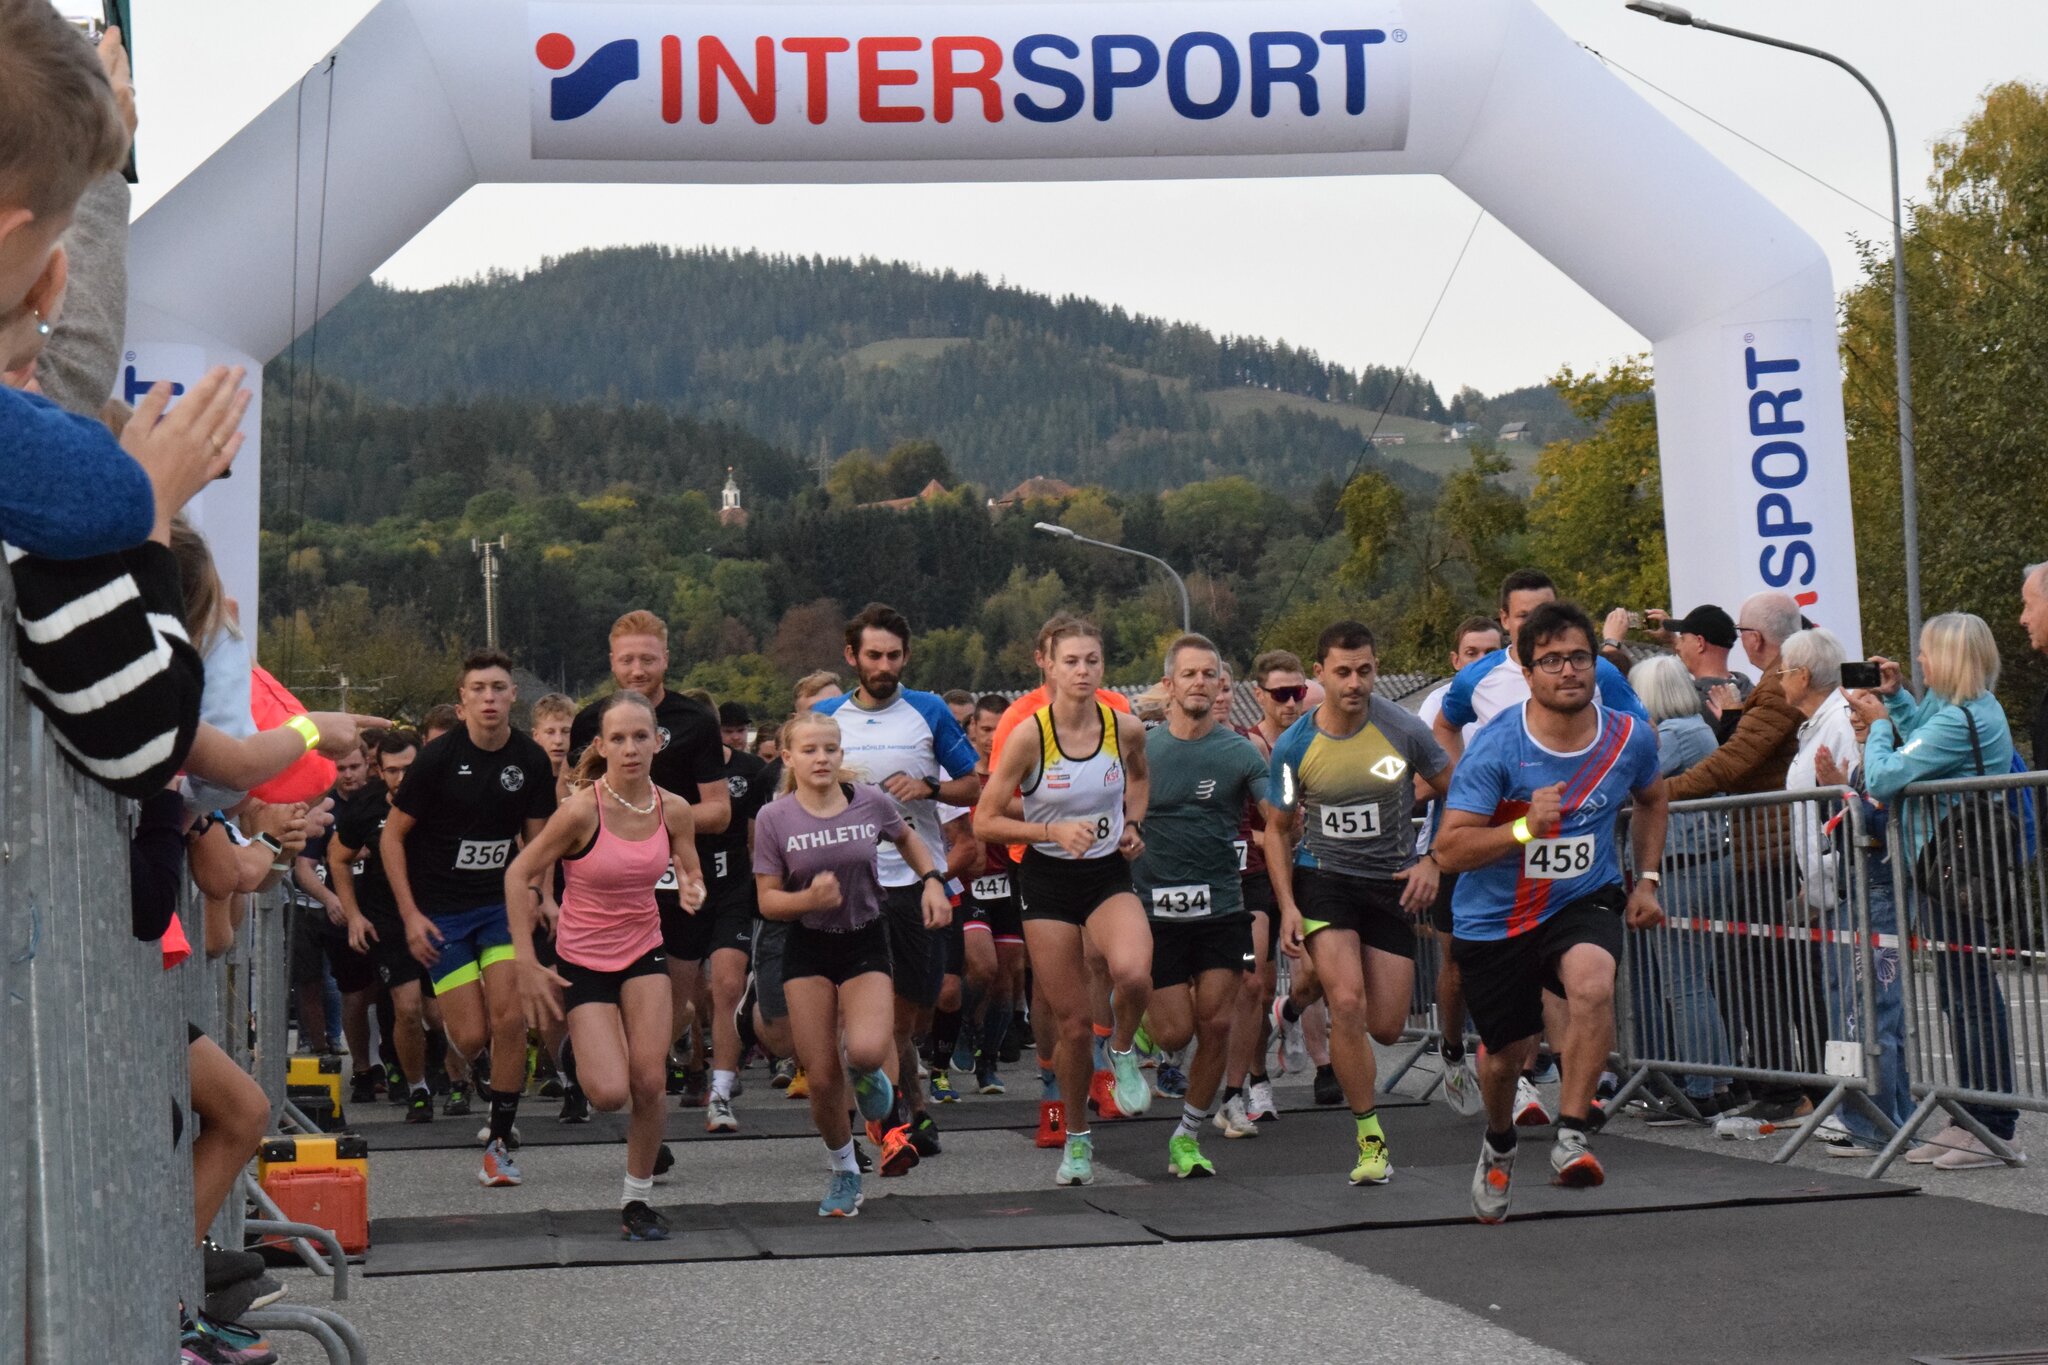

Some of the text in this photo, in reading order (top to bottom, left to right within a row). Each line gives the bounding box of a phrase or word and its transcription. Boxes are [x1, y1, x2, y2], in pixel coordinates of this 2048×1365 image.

[661, 29, 1387, 125] INTERSPORT
[1325, 810, 1376, 833] 451
[786, 823, 876, 852] ATHLETIC
[460, 844, 506, 865] 356
[1529, 842, 1590, 873] 458
[974, 877, 1008, 895] 447
[1157, 890, 1207, 912] 434
